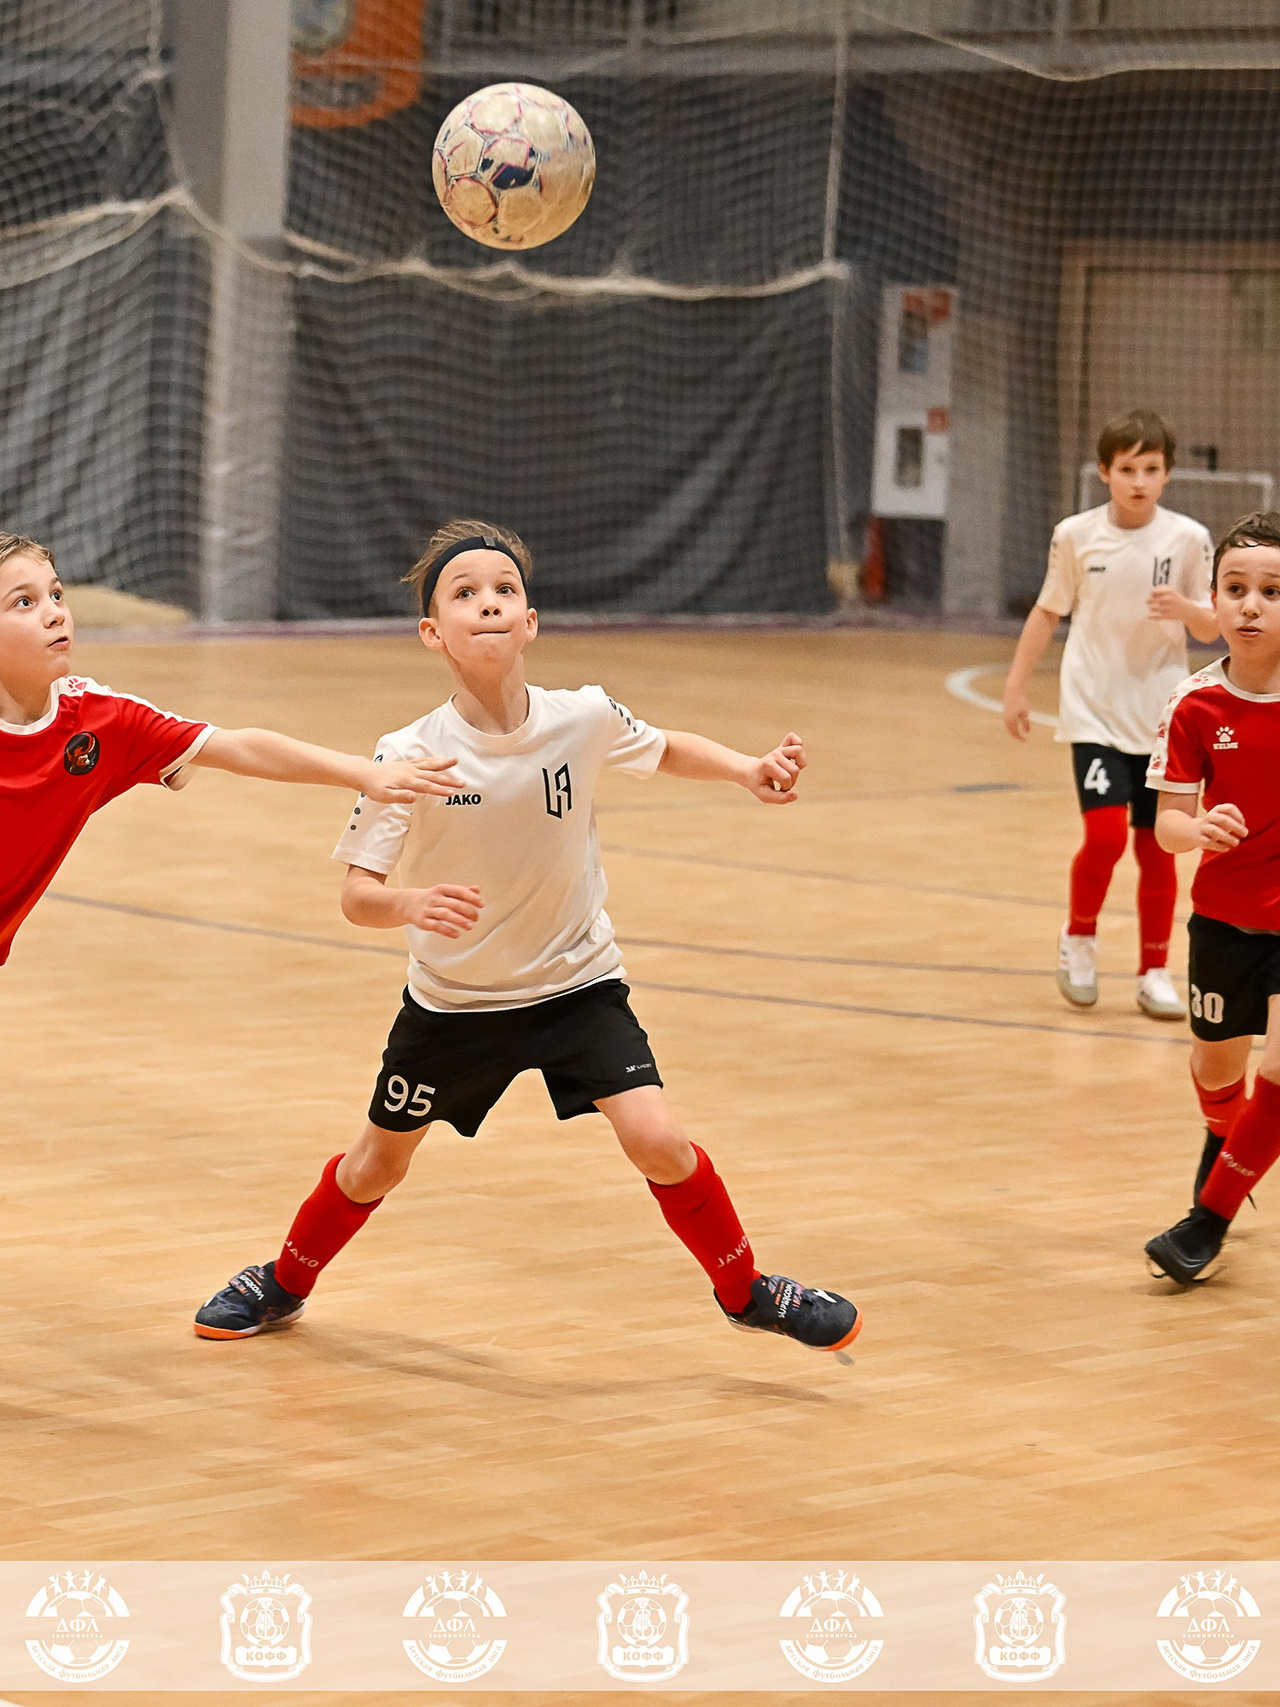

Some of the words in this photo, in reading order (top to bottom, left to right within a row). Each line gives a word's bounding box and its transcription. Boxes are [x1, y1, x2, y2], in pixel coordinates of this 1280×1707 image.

[1083, 758, 1112, 795] 4
[445, 793, 482, 806] JAKO
[1190, 983, 1225, 1024] 30
[383, 1074, 436, 1117] 95
[285, 1240, 320, 1268] JAKO
[717, 1235, 748, 1268] JAKO
